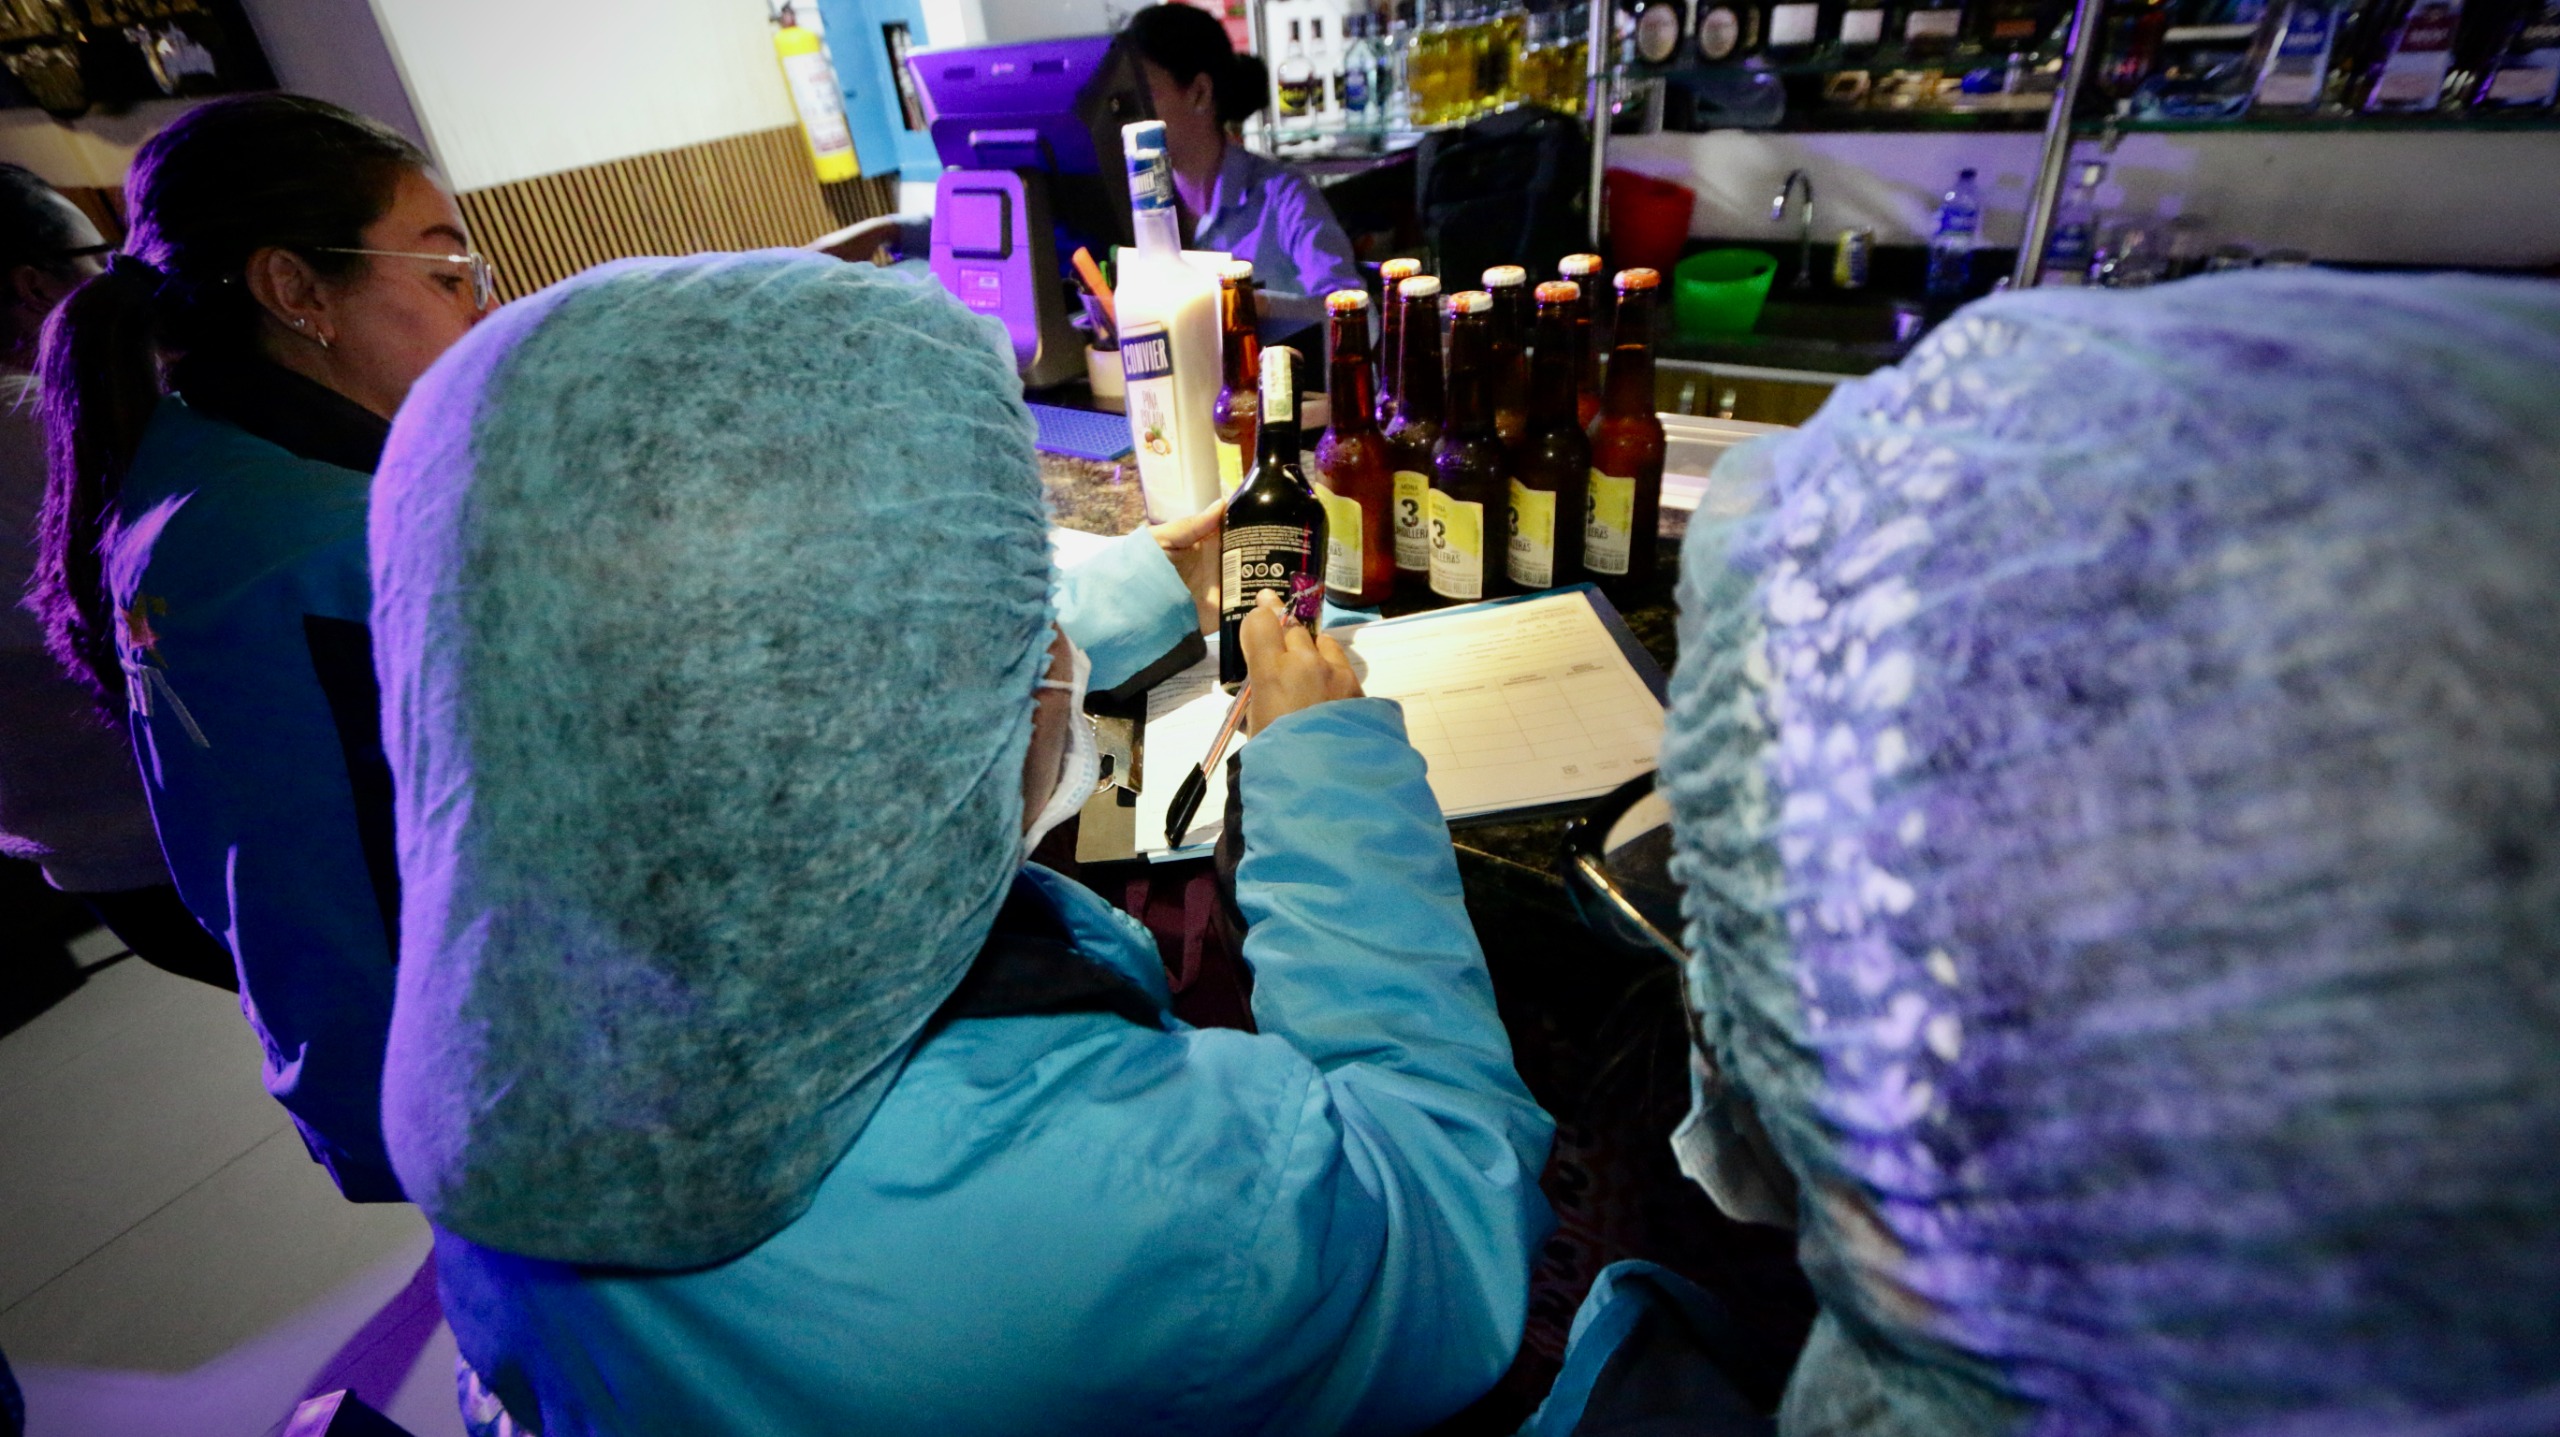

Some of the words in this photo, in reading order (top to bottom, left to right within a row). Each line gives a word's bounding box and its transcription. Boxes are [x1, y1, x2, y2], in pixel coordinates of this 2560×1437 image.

[1123, 338, 1169, 375] CONVIER
[1401, 498, 1420, 528] 3
[1433, 518, 1446, 549] 3
